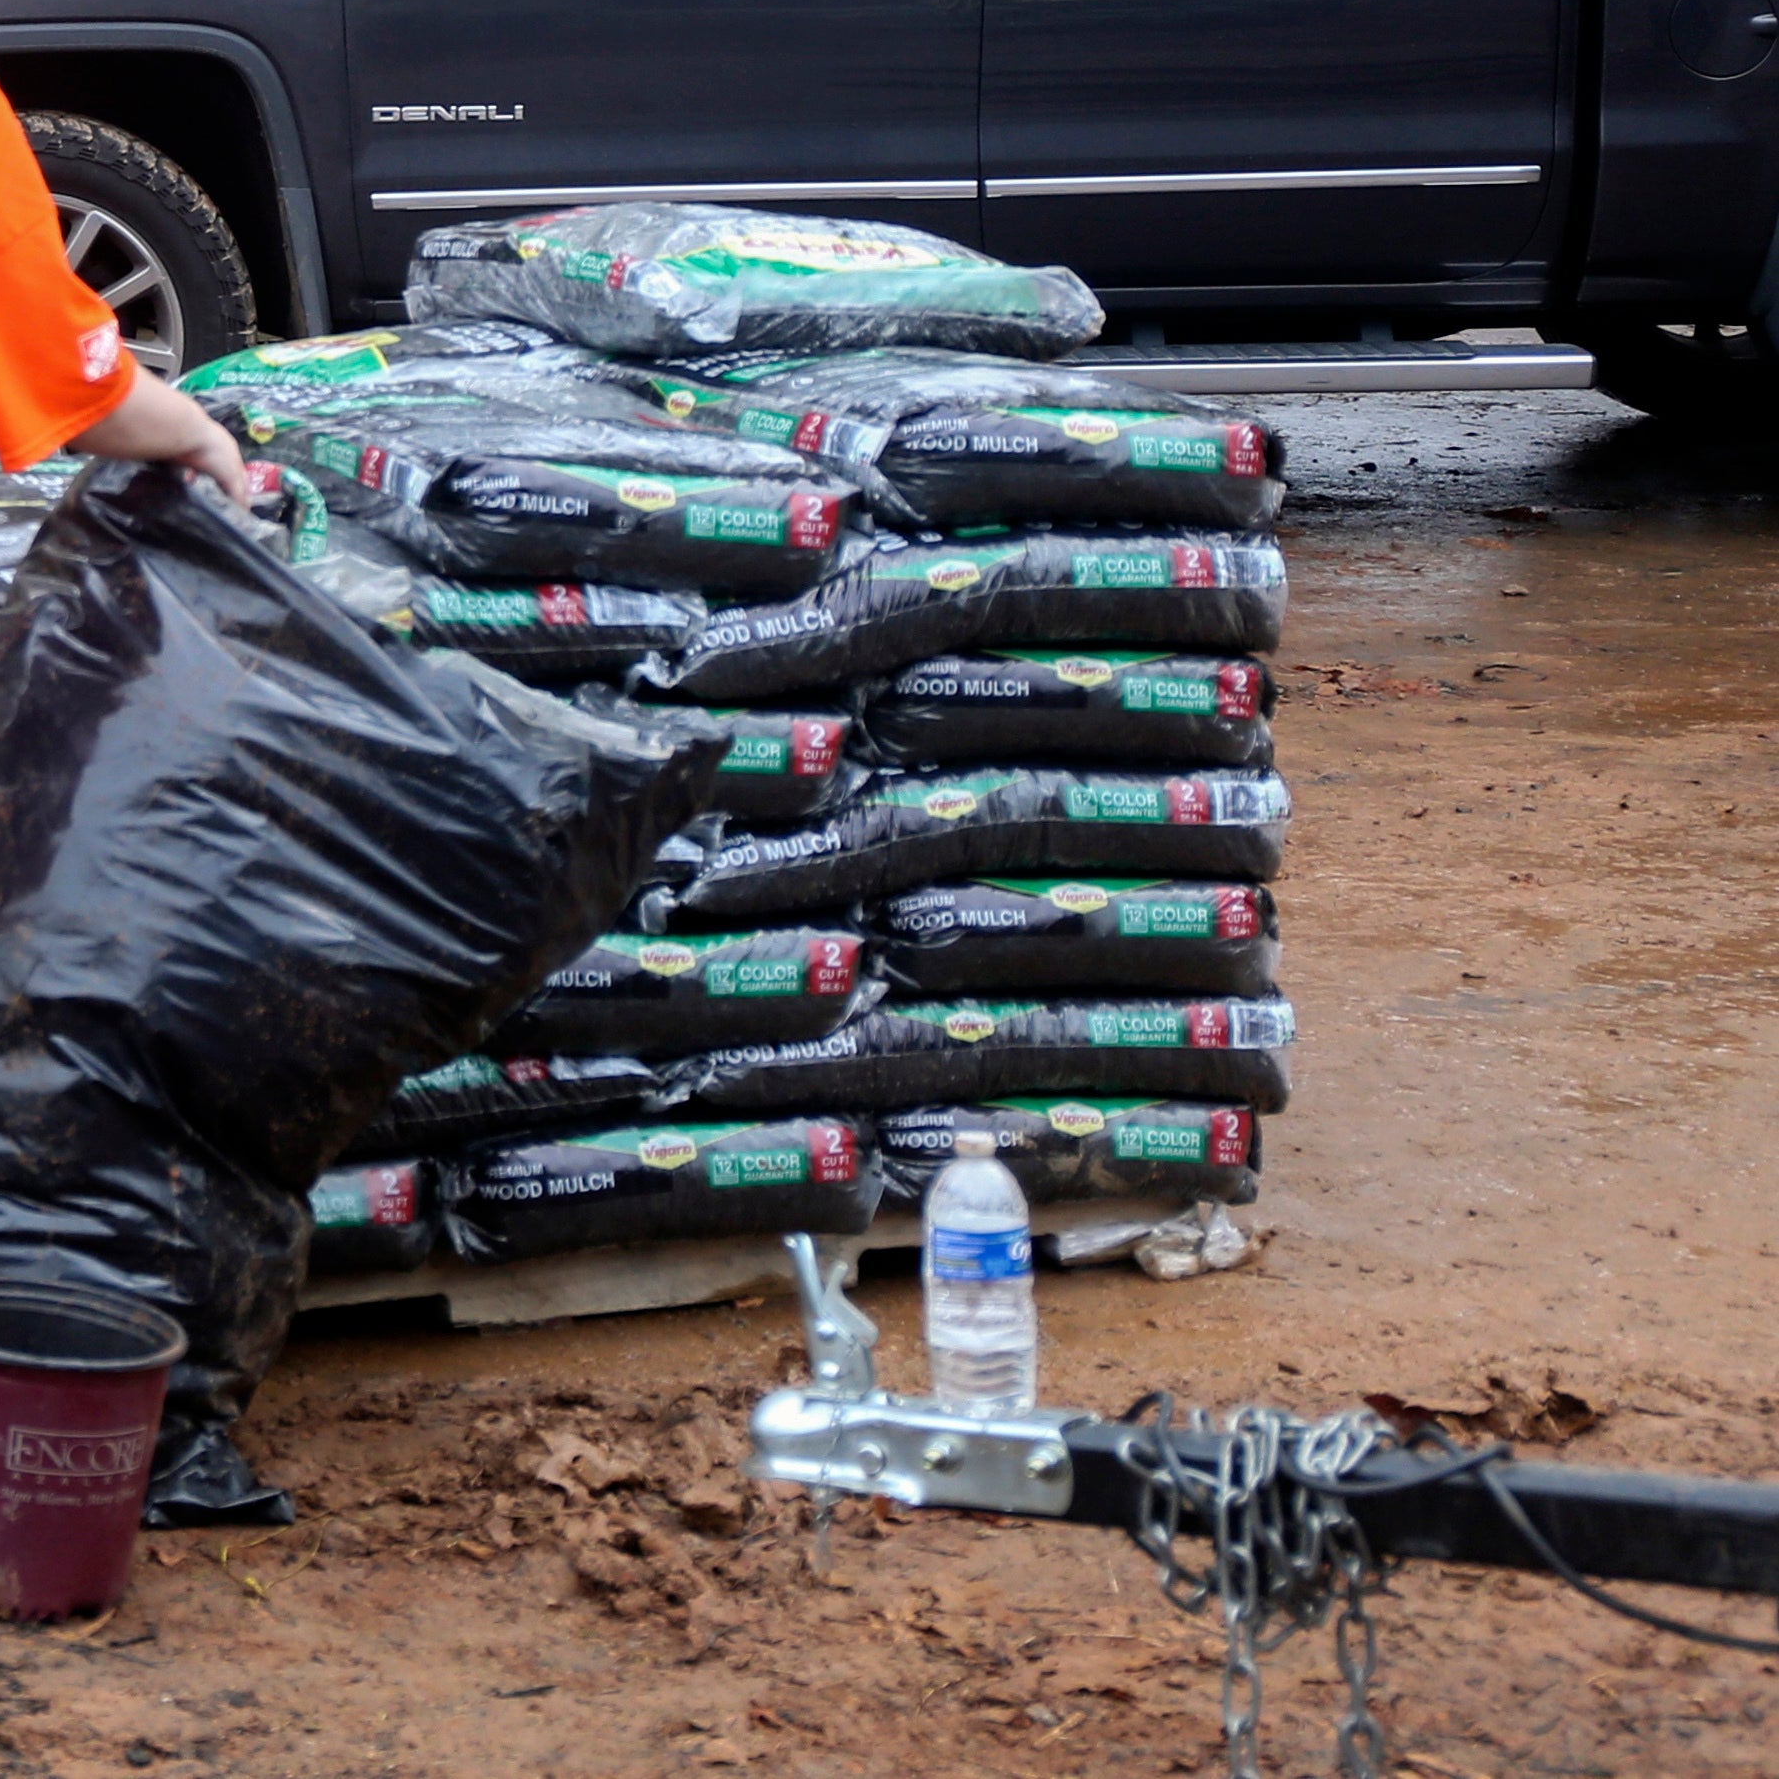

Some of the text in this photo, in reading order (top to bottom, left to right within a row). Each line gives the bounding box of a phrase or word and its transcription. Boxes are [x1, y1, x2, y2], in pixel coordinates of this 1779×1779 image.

[372, 105, 524, 121] DENALI
[758, 414, 794, 433] COLOR
[807, 415, 821, 433] 2
[902, 419, 969, 435] PREMIUM
[1066, 421, 1114, 439] Vigoro
[974, 436, 1039, 453] MULCH
[1241, 426, 1255, 449] 2
[1162, 441, 1217, 459] COLOR
[1164, 457, 1217, 470] GUARANTEE
[453, 475, 521, 492] PREMIUM
[622, 484, 671, 503] Vigoro
[522, 496, 590, 516] MULCH
[807, 497, 822, 521] 2
[721, 511, 779, 529] COLOR
[801, 523, 830, 534] CU FT
[721, 527, 780, 540] GUARANTEE
[1106, 559, 1162, 575] COLOR
[1187, 550, 1200, 568] 2
[931, 567, 977, 585] Vigoro
[1107, 573, 1165, 585] GUARANTEE
[553, 586, 566, 603] 2
[759, 609, 836, 639] MULCH
[897, 679, 1030, 696] WOOD MULCH
[1234, 670, 1248, 692] 2
[1156, 683, 1211, 700] COLOR
[1157, 698, 1212, 710] GUARANTEE
[810, 724, 826, 747] 2
[803, 750, 833, 760] CU FT
[1101, 793, 1158, 808] COLOR
[1182, 783, 1195, 802] 2
[928, 796, 973, 813] Vigoro
[1102, 807, 1160, 819] GUARANTEE
[768, 831, 841, 862] MULCH
[889, 894, 955, 911] PREMIUM
[1054, 890, 1105, 907] Vigoro
[1231, 891, 1246, 912] 2
[893, 910, 1027, 930] WOOD MULCH
[1152, 907, 1208, 923] COLOR
[1153, 922, 1209, 933] GUARANTEE
[644, 952, 691, 969] Vigoro
[825, 942, 842, 966] 2
[546, 970, 612, 988] MULCH
[741, 965, 798, 981] COLOR
[819, 969, 850, 979] CU FT
[742, 980, 798, 992] GUARANTEE
[1121, 1017, 1177, 1033] COLOR
[1200, 1007, 1214, 1026] 2
[1123, 1032, 1179, 1043] GUARANTEE
[1197, 1027, 1211, 1036] CU
[783, 1036, 858, 1060] MULCH
[889, 1115, 955, 1128] PREMIUM
[1052, 1112, 1101, 1129] Vigoro
[1226, 1115, 1239, 1139] 2
[827, 1130, 843, 1154] 2
[888, 1131, 954, 1148] WOOD
[1147, 1130, 1201, 1147] COLOR
[1219, 1141, 1233, 1151] CU
[645, 1143, 692, 1162] Vigoro
[1148, 1146, 1201, 1157] GUARANTEE
[742, 1154, 800, 1171] COLOR
[822, 1157, 837, 1167] CU
[382, 1170, 400, 1195] 2
[744, 1169, 802, 1182] GUARANTEE
[480, 1172, 616, 1200] WOOD MULCH
